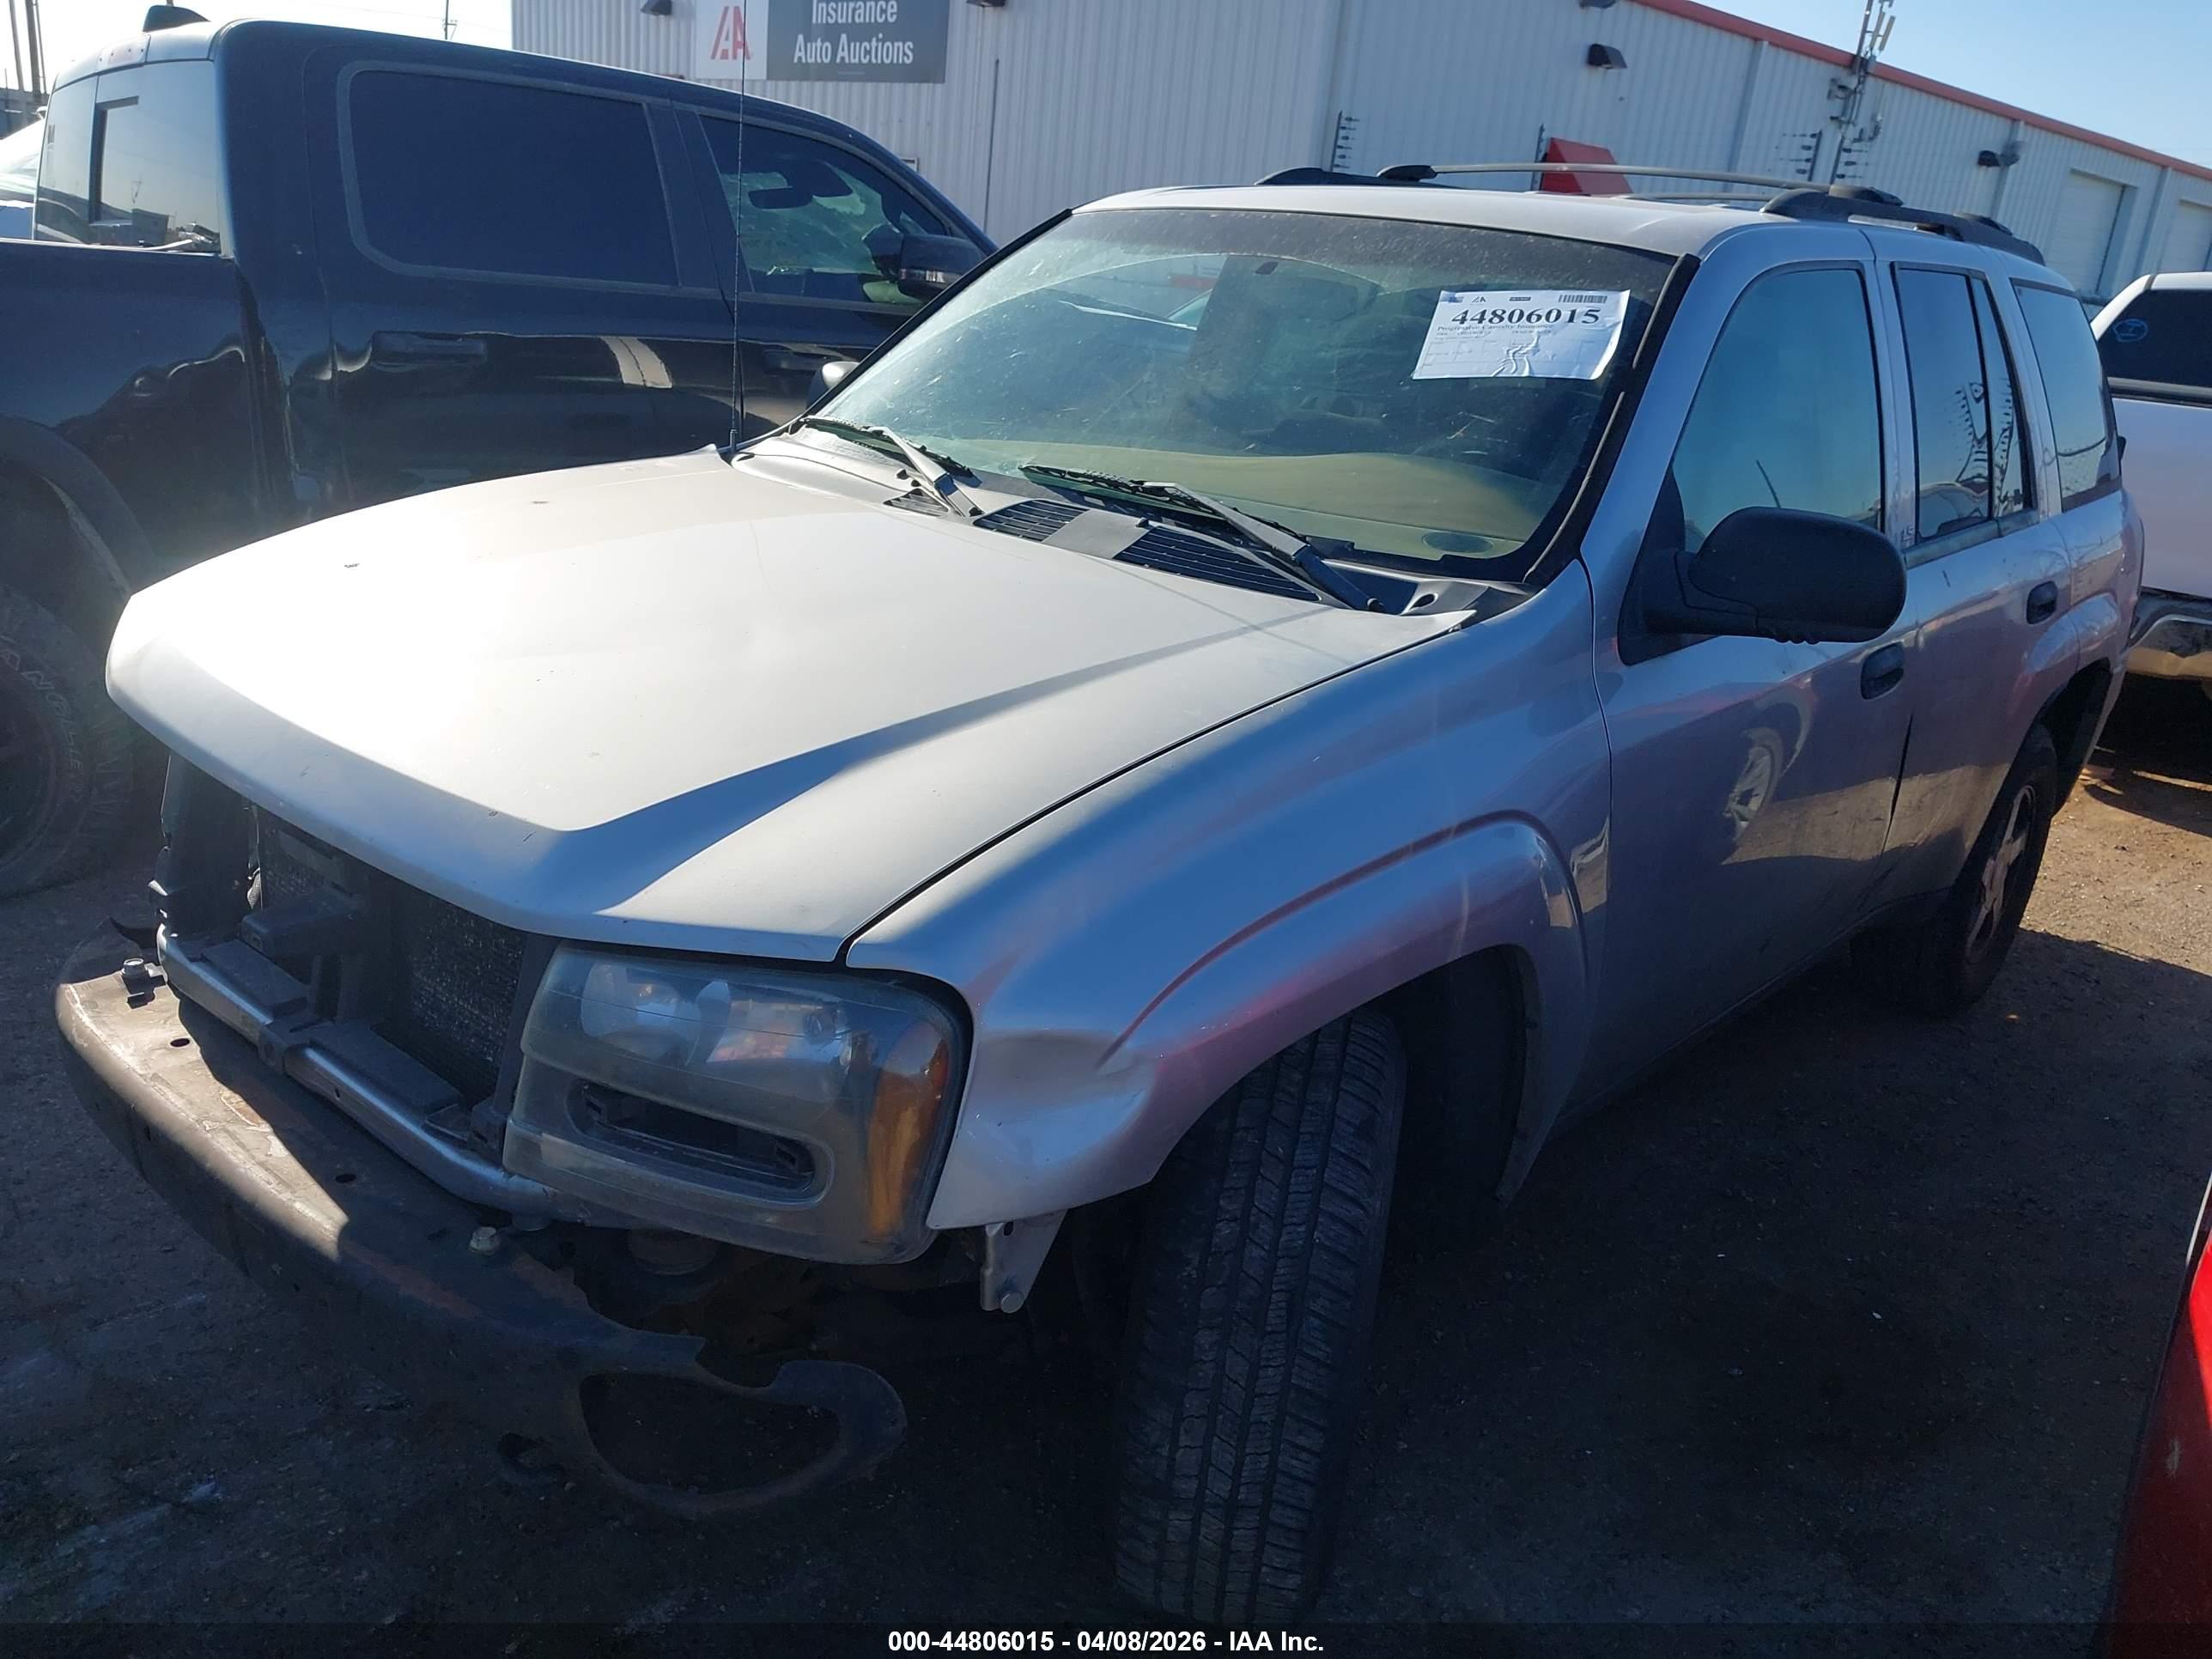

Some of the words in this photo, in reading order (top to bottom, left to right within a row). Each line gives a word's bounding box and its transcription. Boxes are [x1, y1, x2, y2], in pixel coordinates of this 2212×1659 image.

[811, 0, 898, 24] Insurance
[793, 33, 832, 64] Auto
[836, 32, 915, 64] Auctions
[1451, 307, 1601, 325] 44806015
